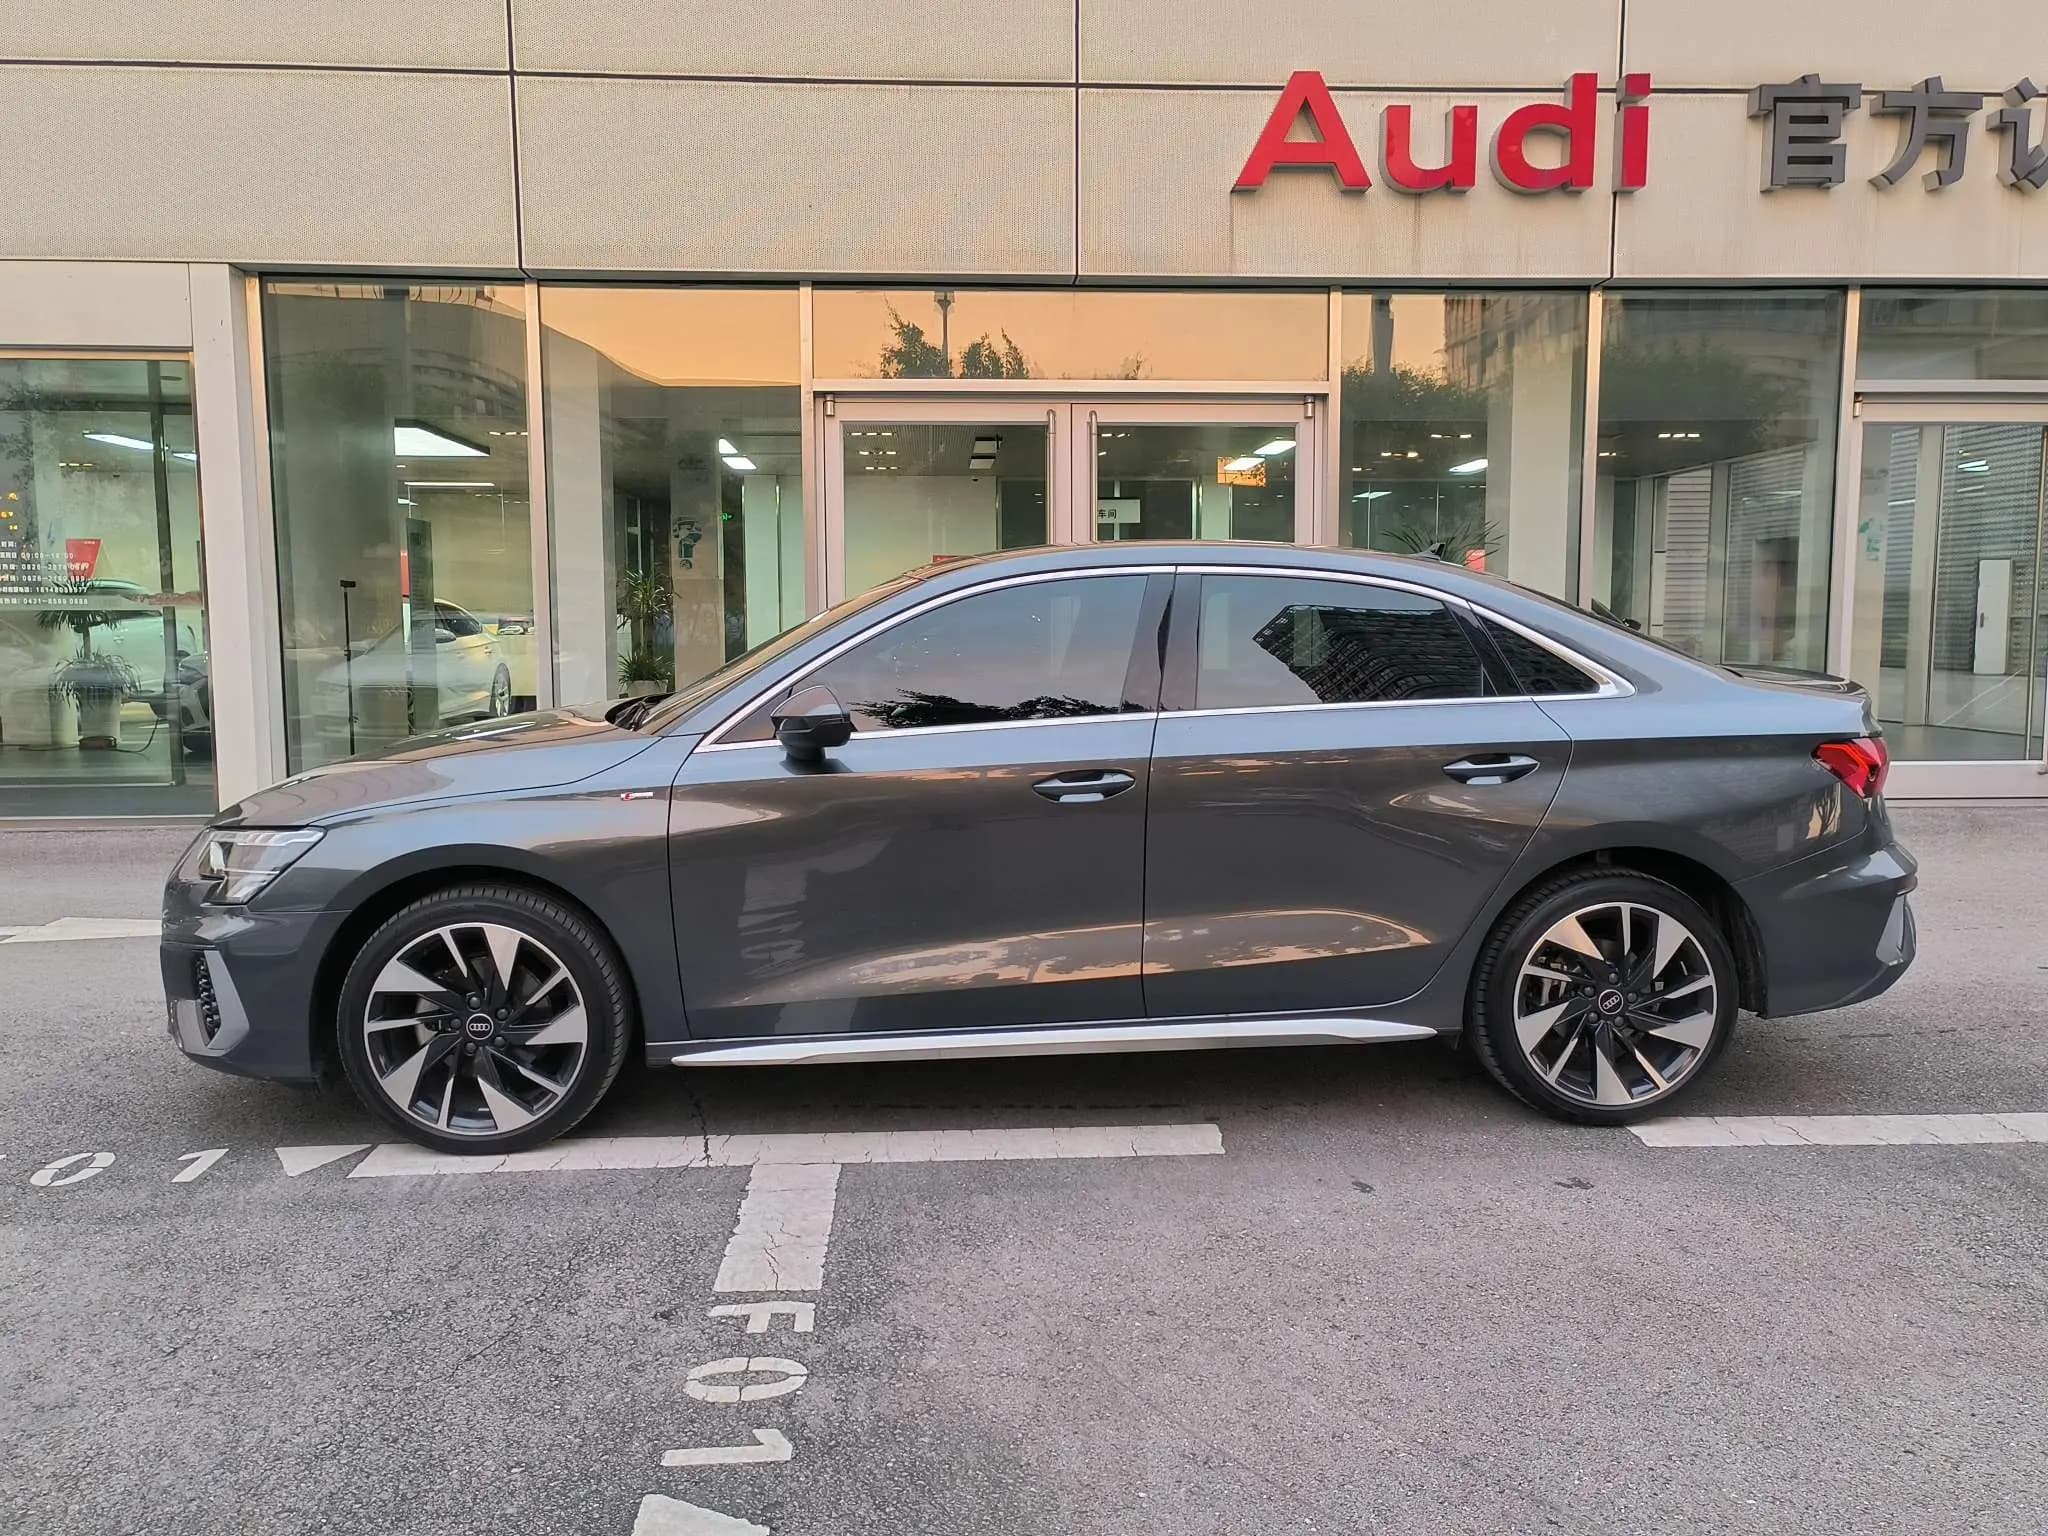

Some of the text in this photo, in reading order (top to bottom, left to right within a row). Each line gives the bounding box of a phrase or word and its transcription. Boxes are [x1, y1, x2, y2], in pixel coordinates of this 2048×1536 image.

[1232, 70, 1652, 193] Audi
[0, 1148, 230, 1187] 01
[660, 1300, 816, 1467] F01
